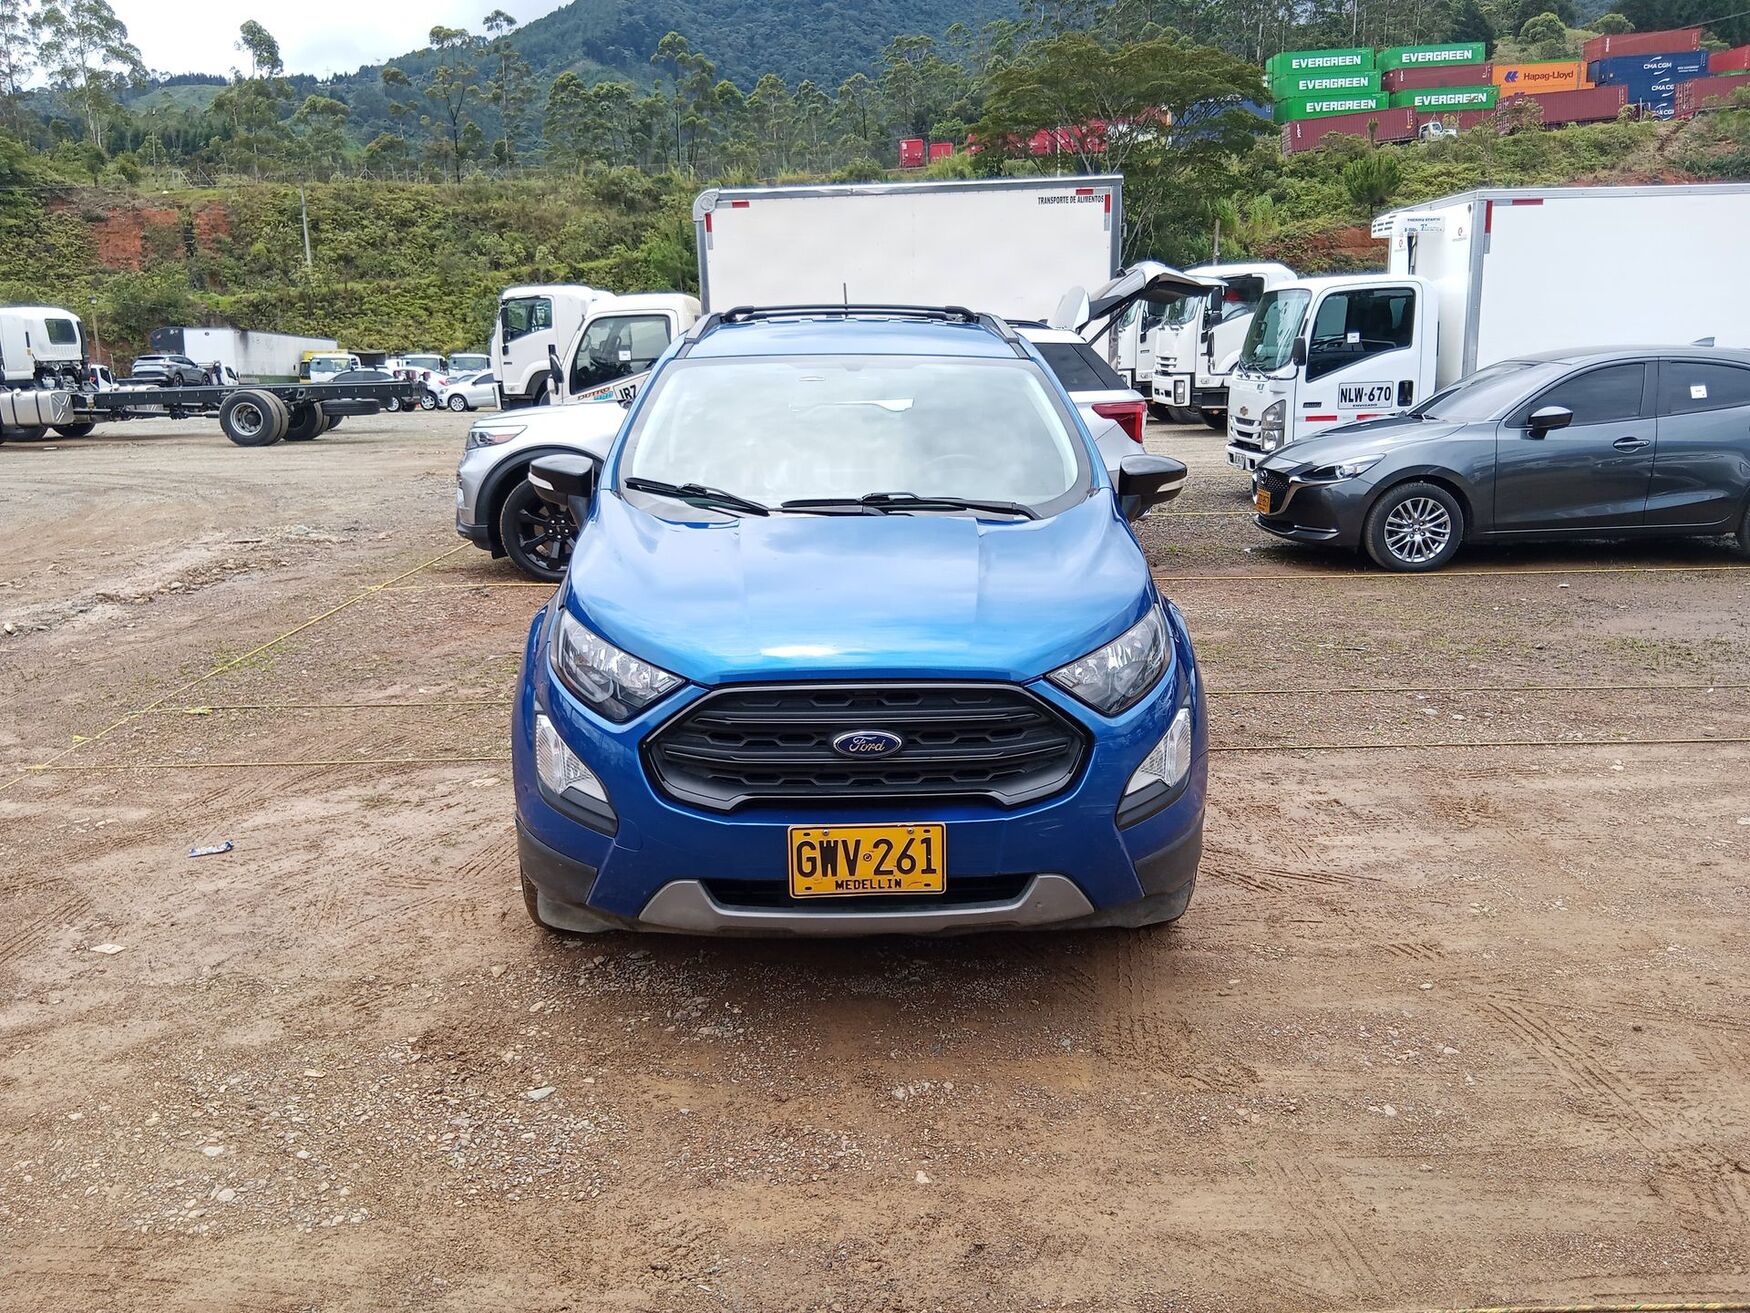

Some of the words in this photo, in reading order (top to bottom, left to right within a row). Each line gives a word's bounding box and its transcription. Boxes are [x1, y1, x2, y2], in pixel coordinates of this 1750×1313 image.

[1292, 55, 1361, 69] EVERGREEN
[1402, 50, 1472, 63] EVERGREEN
[1523, 70, 1574, 81] Hapag-Lloyd
[1299, 77, 1369, 90] EVERGREEN
[1306, 99, 1376, 113] EVERGREEN
[1414, 93, 1487, 106] EVERGREEN
[1038, 196, 1069, 205] TRANSPORTE
[1070, 196, 1076, 204] DE
[1077, 195, 1104, 204] ALIMENTOS
[848, 736, 886, 752] Ford
[835, 879, 902, 891] MEDELLIN
